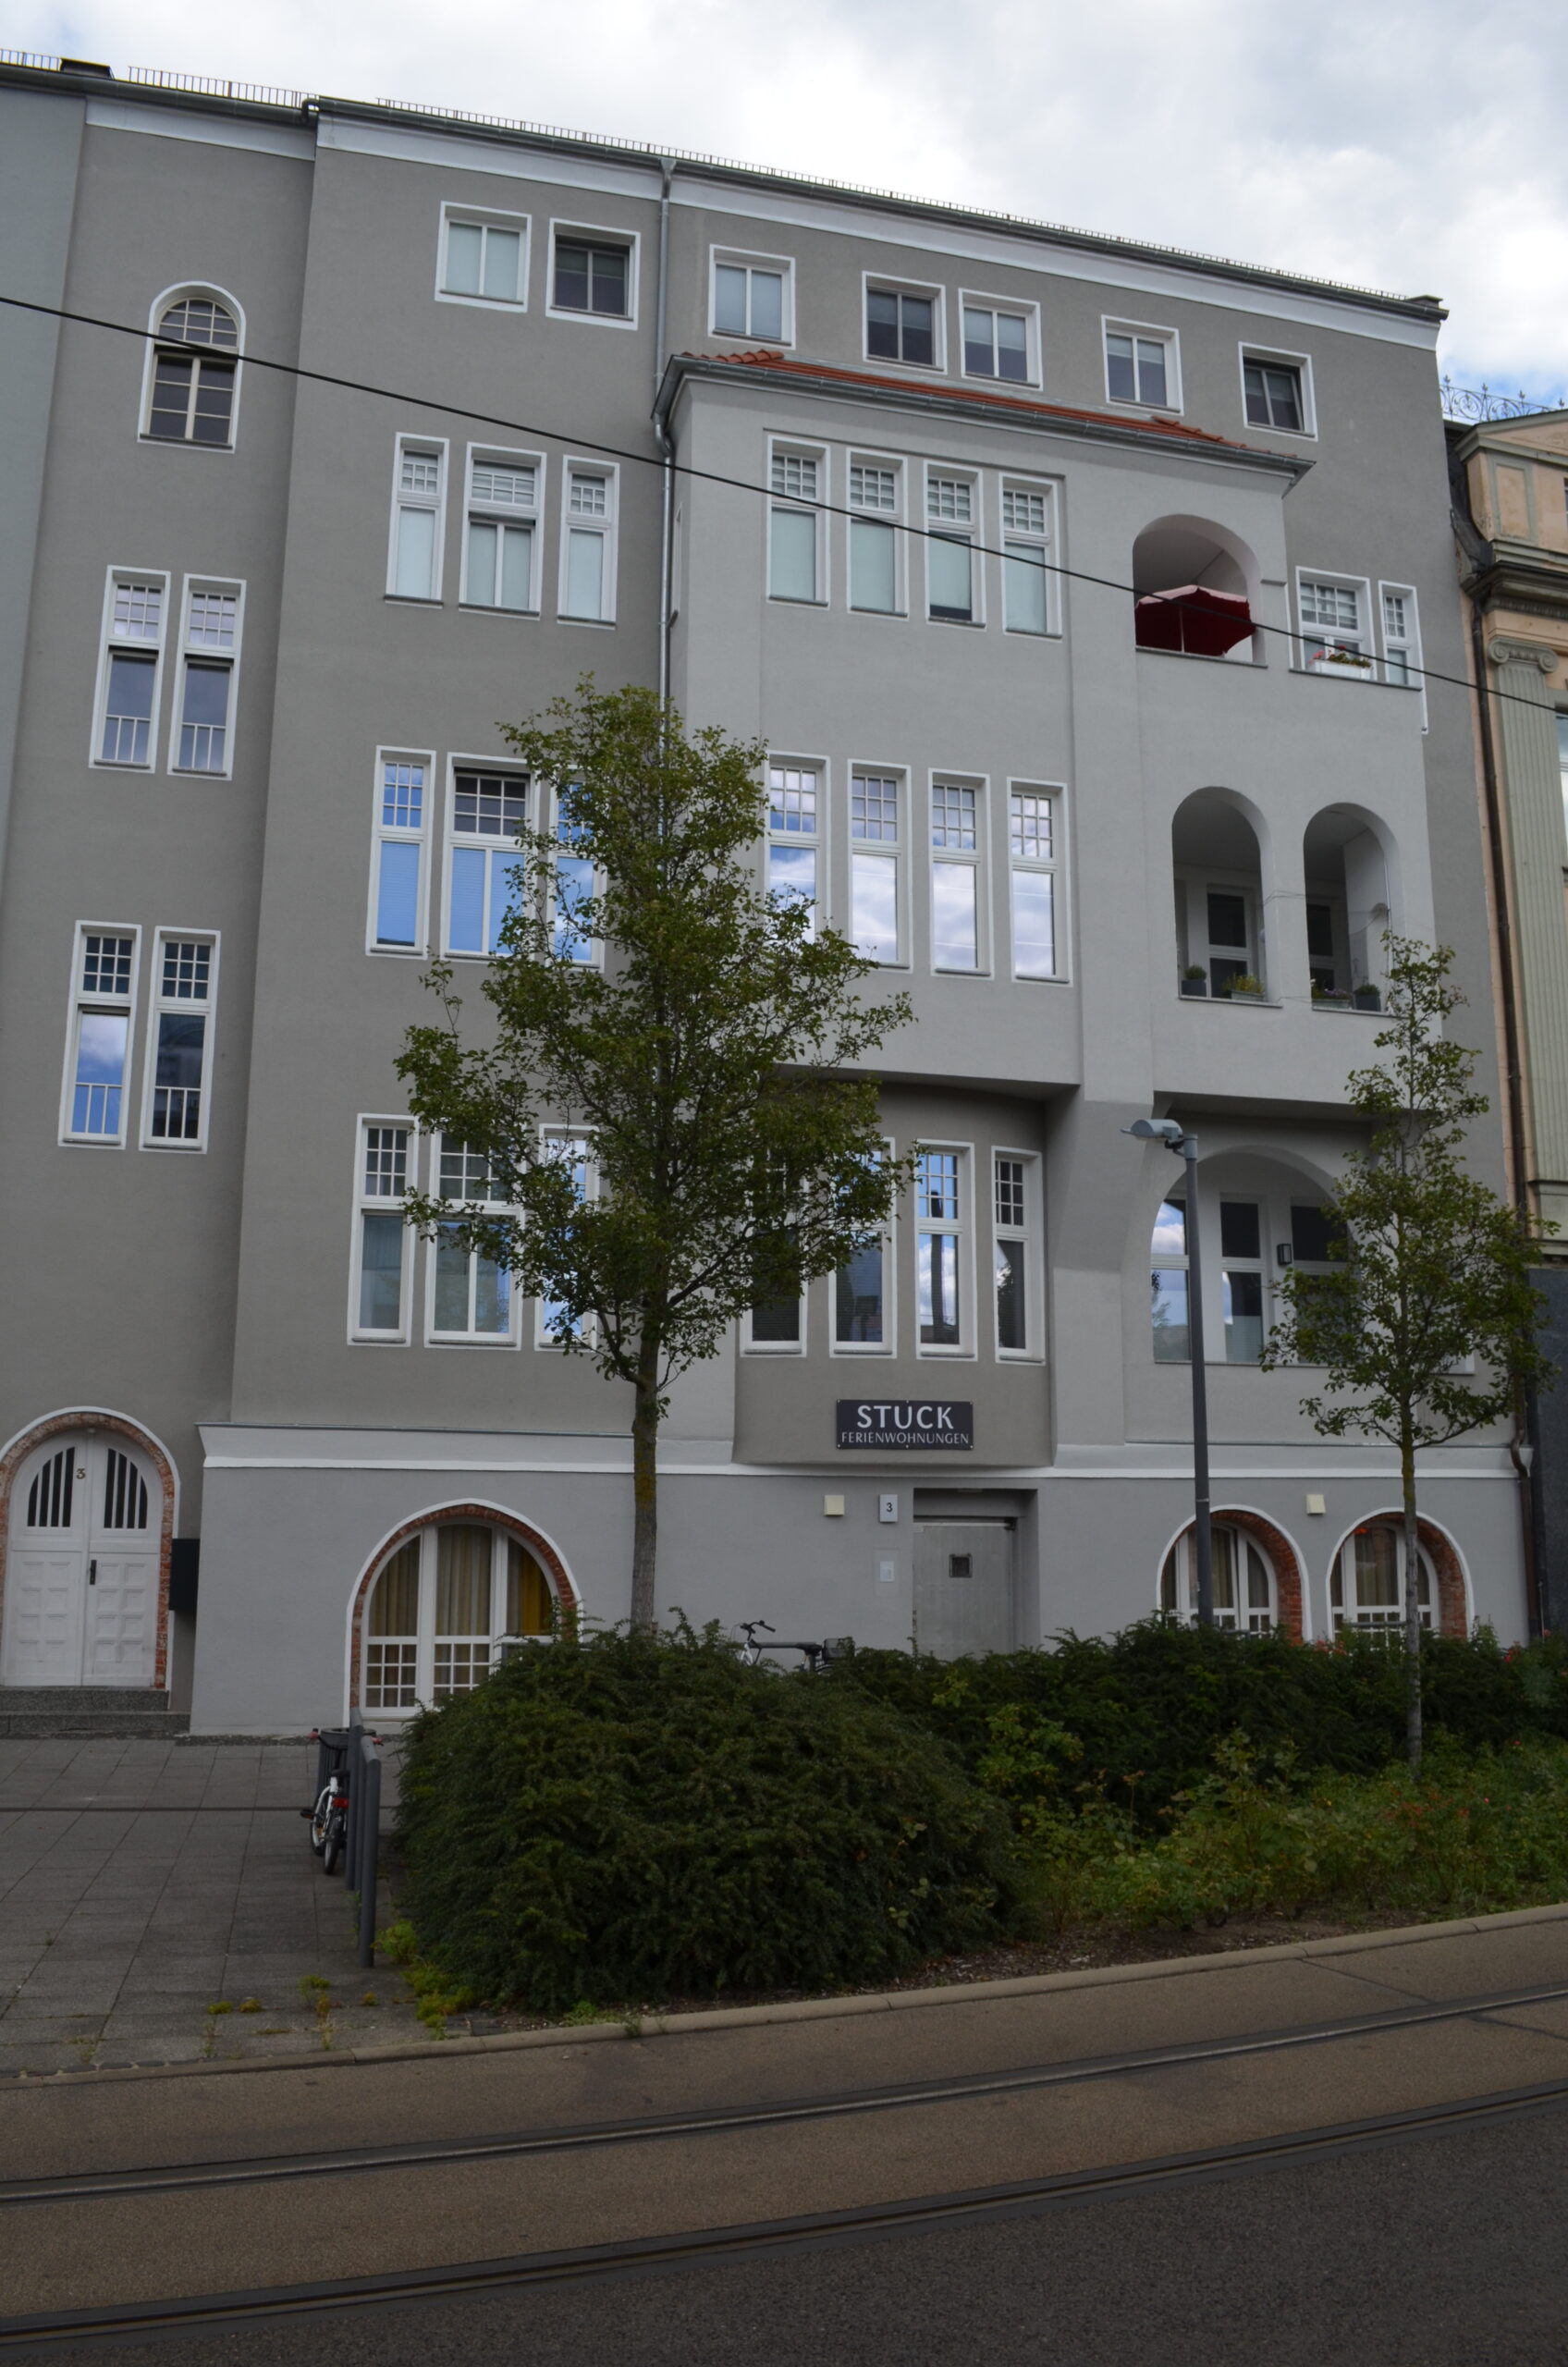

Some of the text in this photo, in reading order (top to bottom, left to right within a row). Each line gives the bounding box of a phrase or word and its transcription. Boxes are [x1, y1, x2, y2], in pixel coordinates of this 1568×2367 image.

[857, 1404, 954, 1429] STUCK
[841, 1431, 969, 1444] FERIENWOHNUNGEN
[76, 1467, 86, 1479] 3
[886, 1502, 893, 1513] 3
